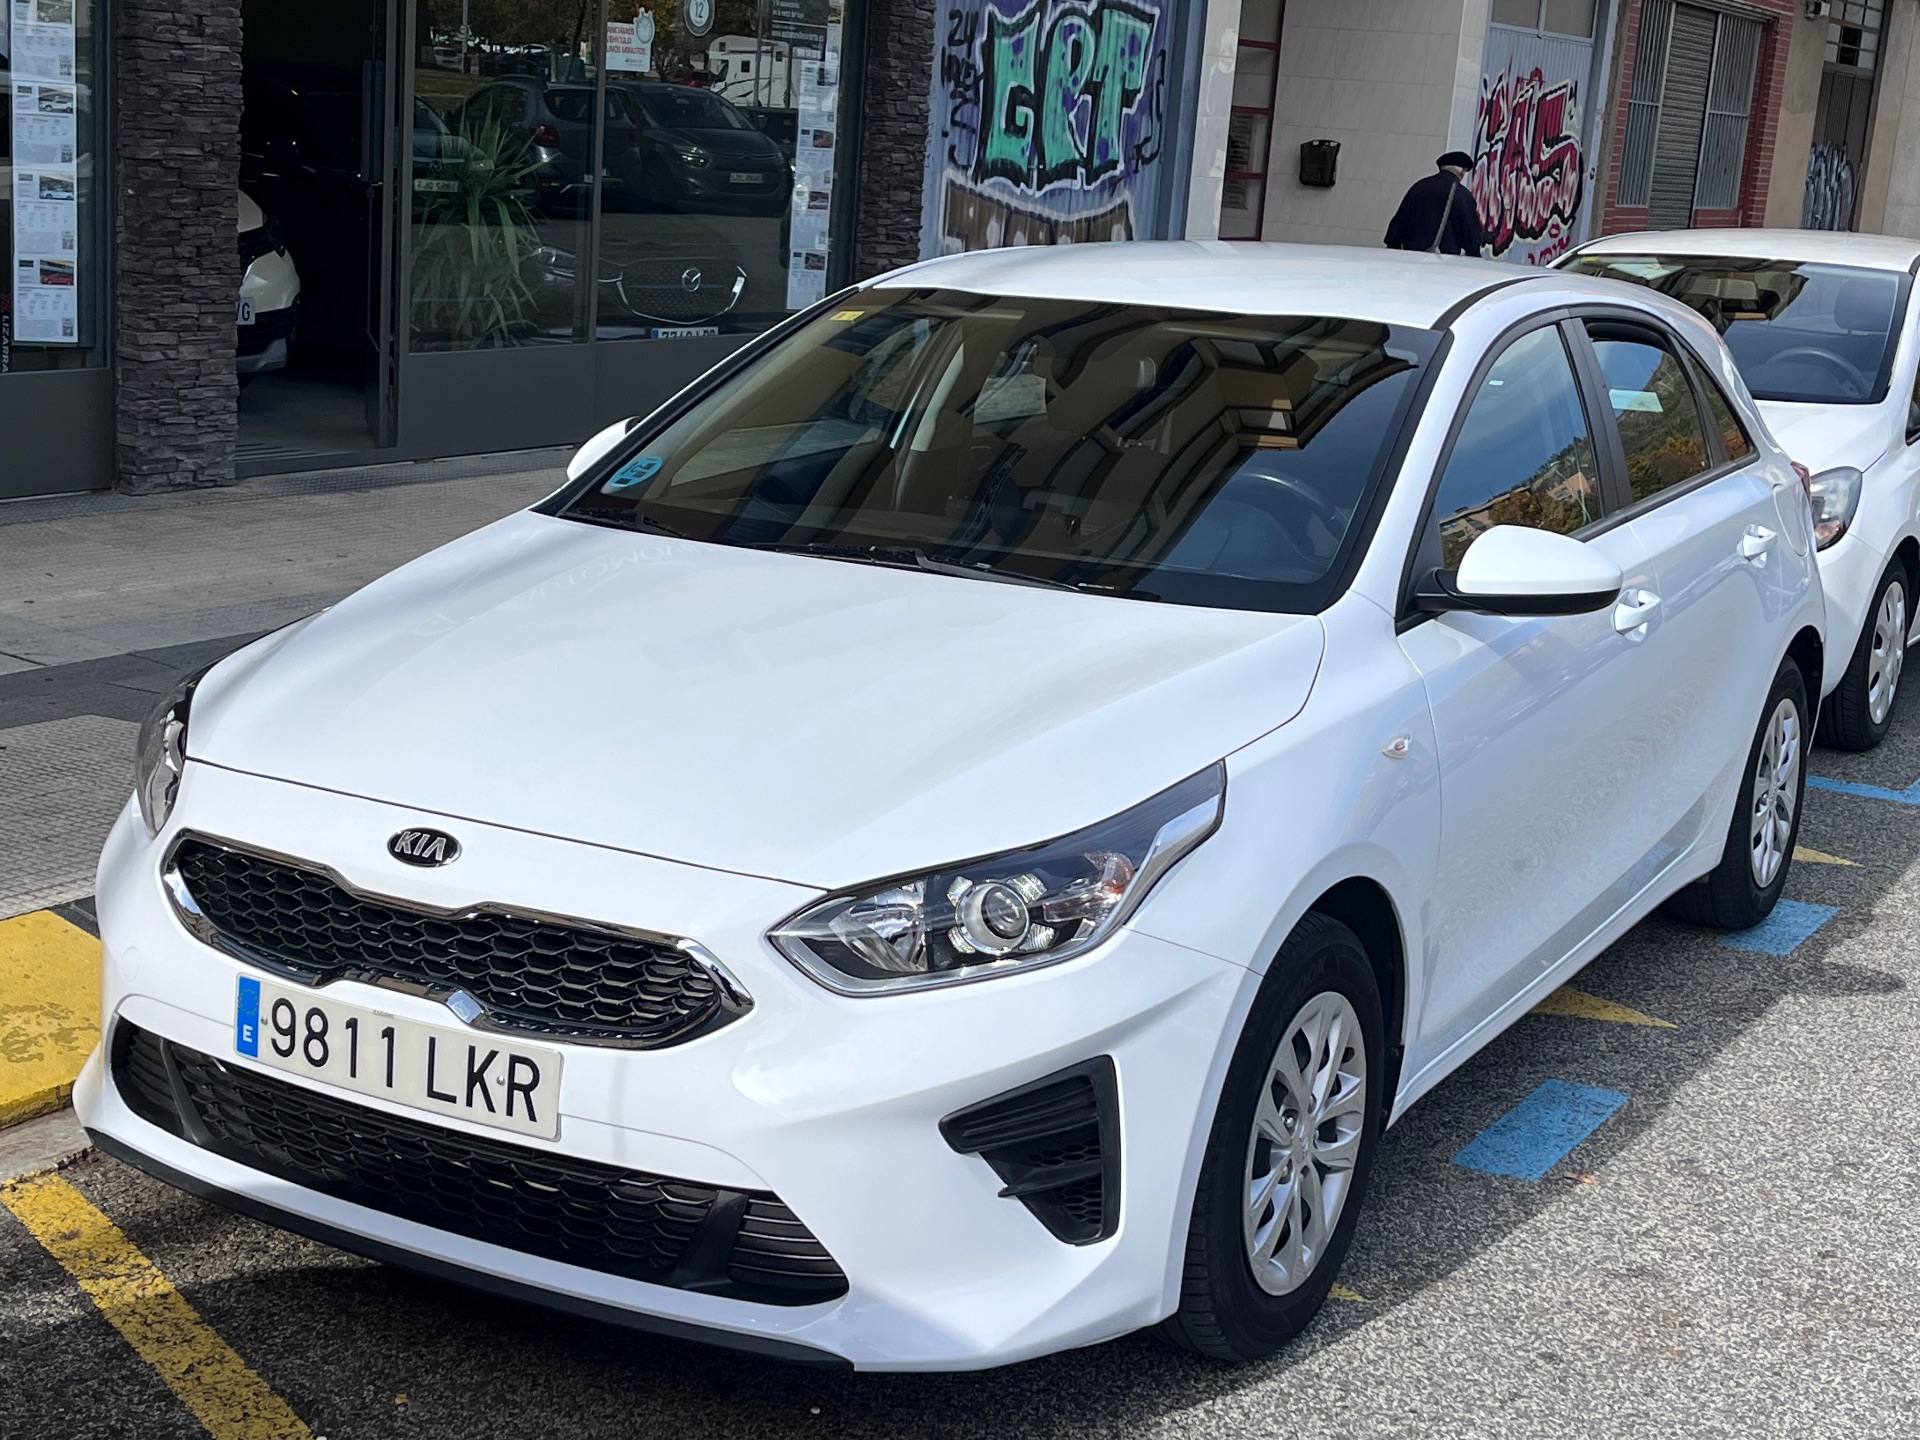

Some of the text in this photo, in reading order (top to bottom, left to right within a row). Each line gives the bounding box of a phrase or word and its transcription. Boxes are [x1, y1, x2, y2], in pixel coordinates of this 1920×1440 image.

[2, 315, 10, 373] LIZARRA
[394, 831, 447, 861] KIA
[242, 1026, 253, 1043] E
[271, 997, 541, 1123] 9811 LKR
